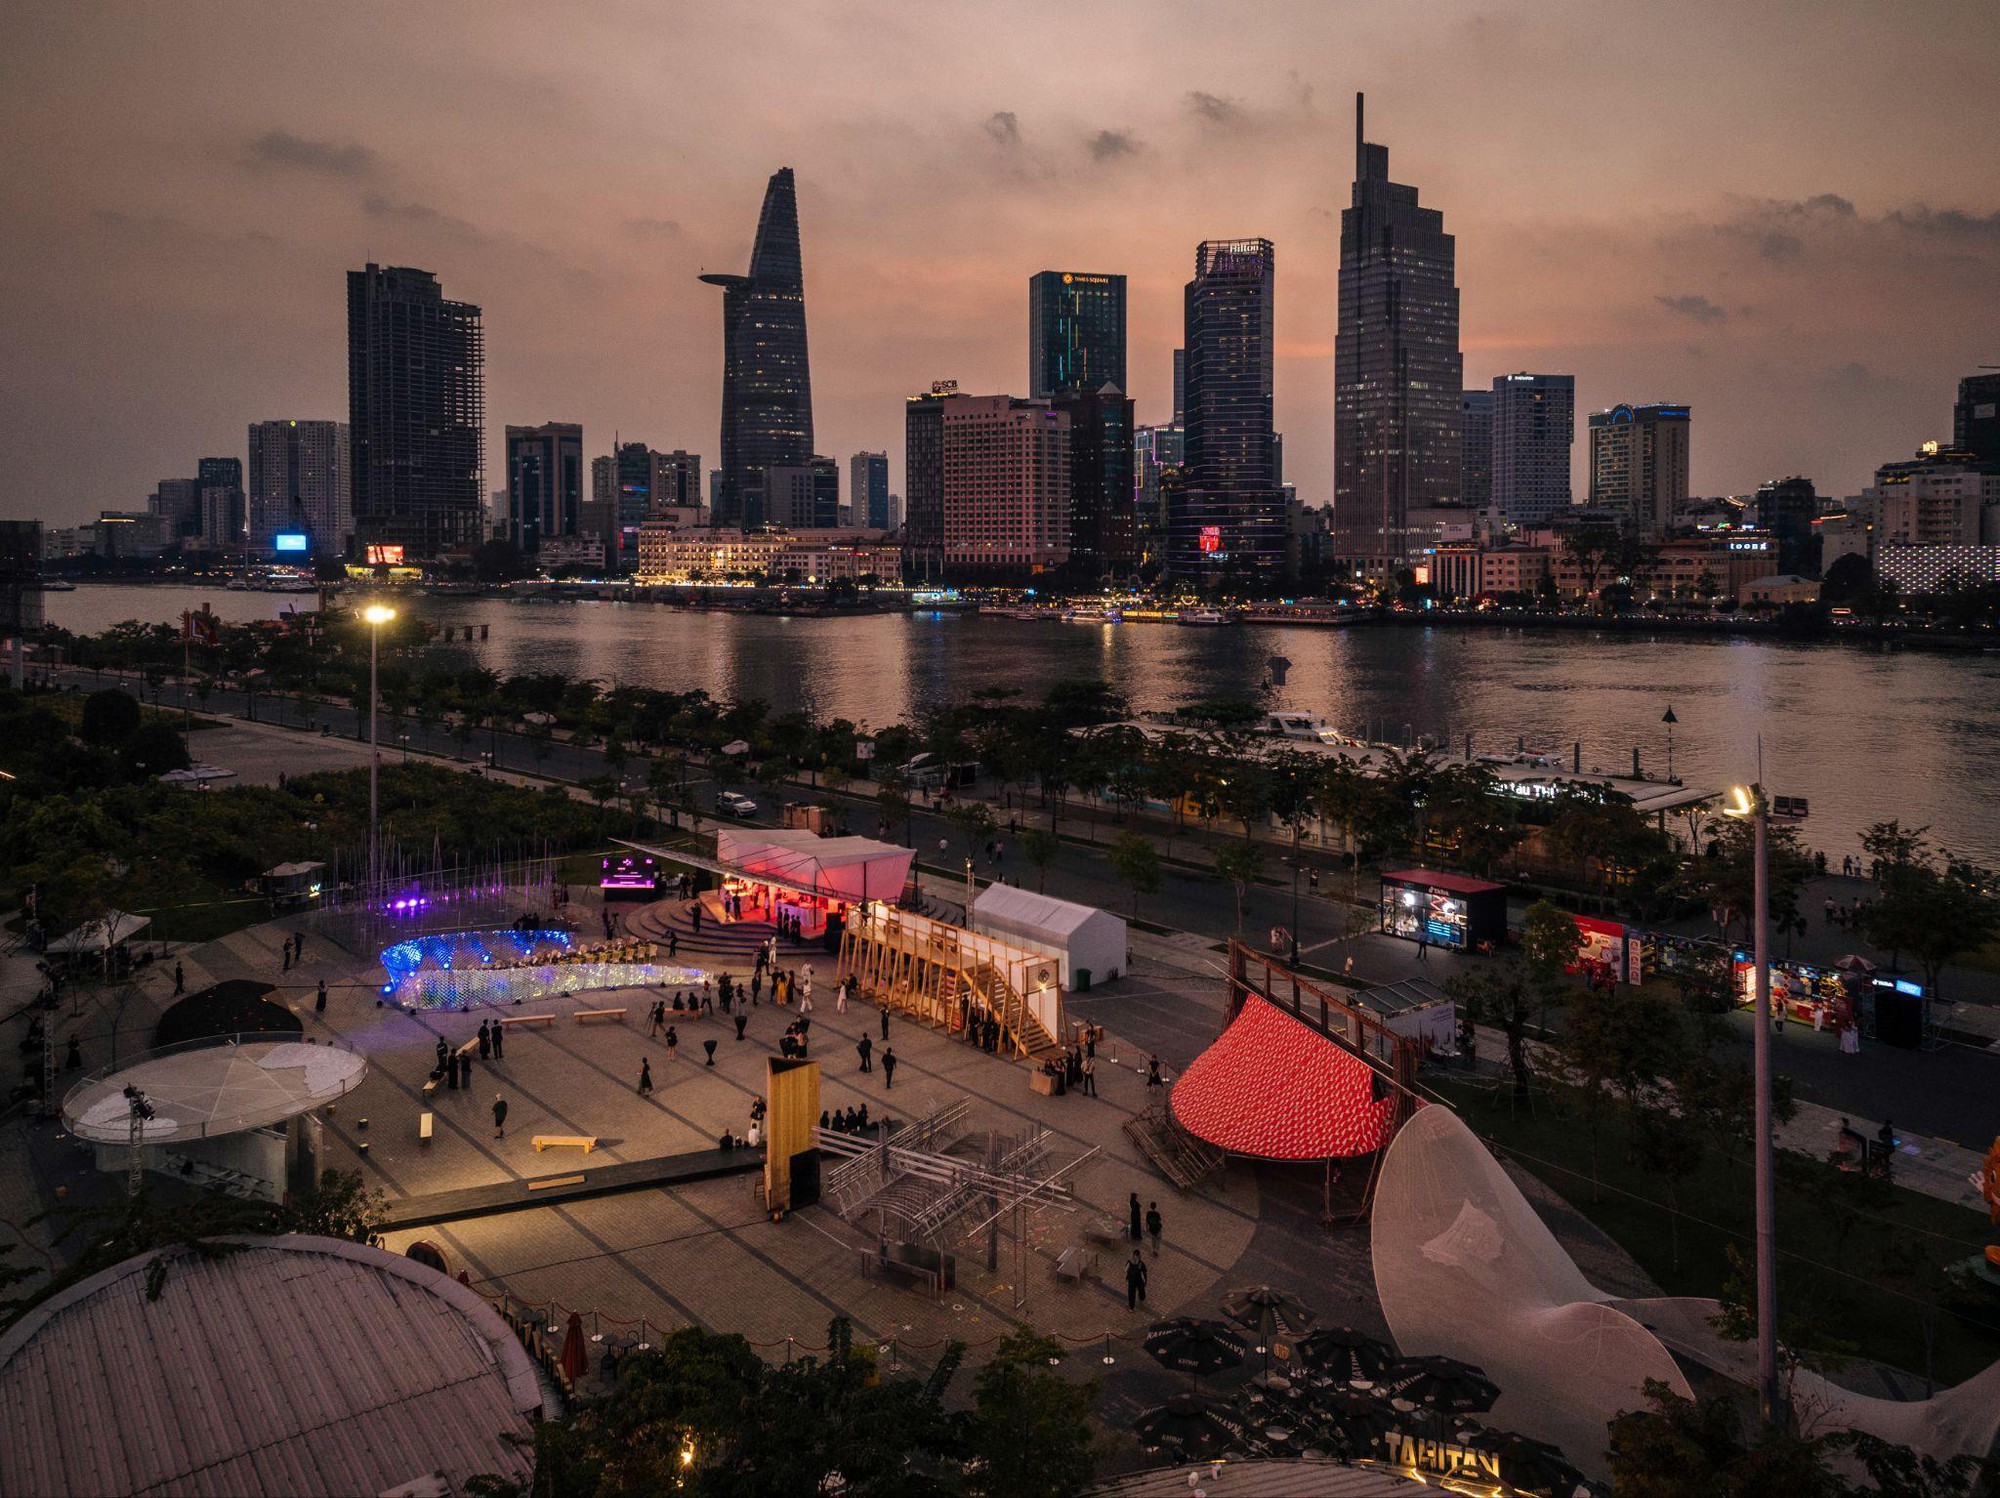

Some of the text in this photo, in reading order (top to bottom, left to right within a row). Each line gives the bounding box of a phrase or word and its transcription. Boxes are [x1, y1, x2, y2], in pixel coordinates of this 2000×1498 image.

[1229, 244, 1259, 253] Hilton
[941, 380, 957, 388] SCB
[1730, 542, 1768, 550] toong
